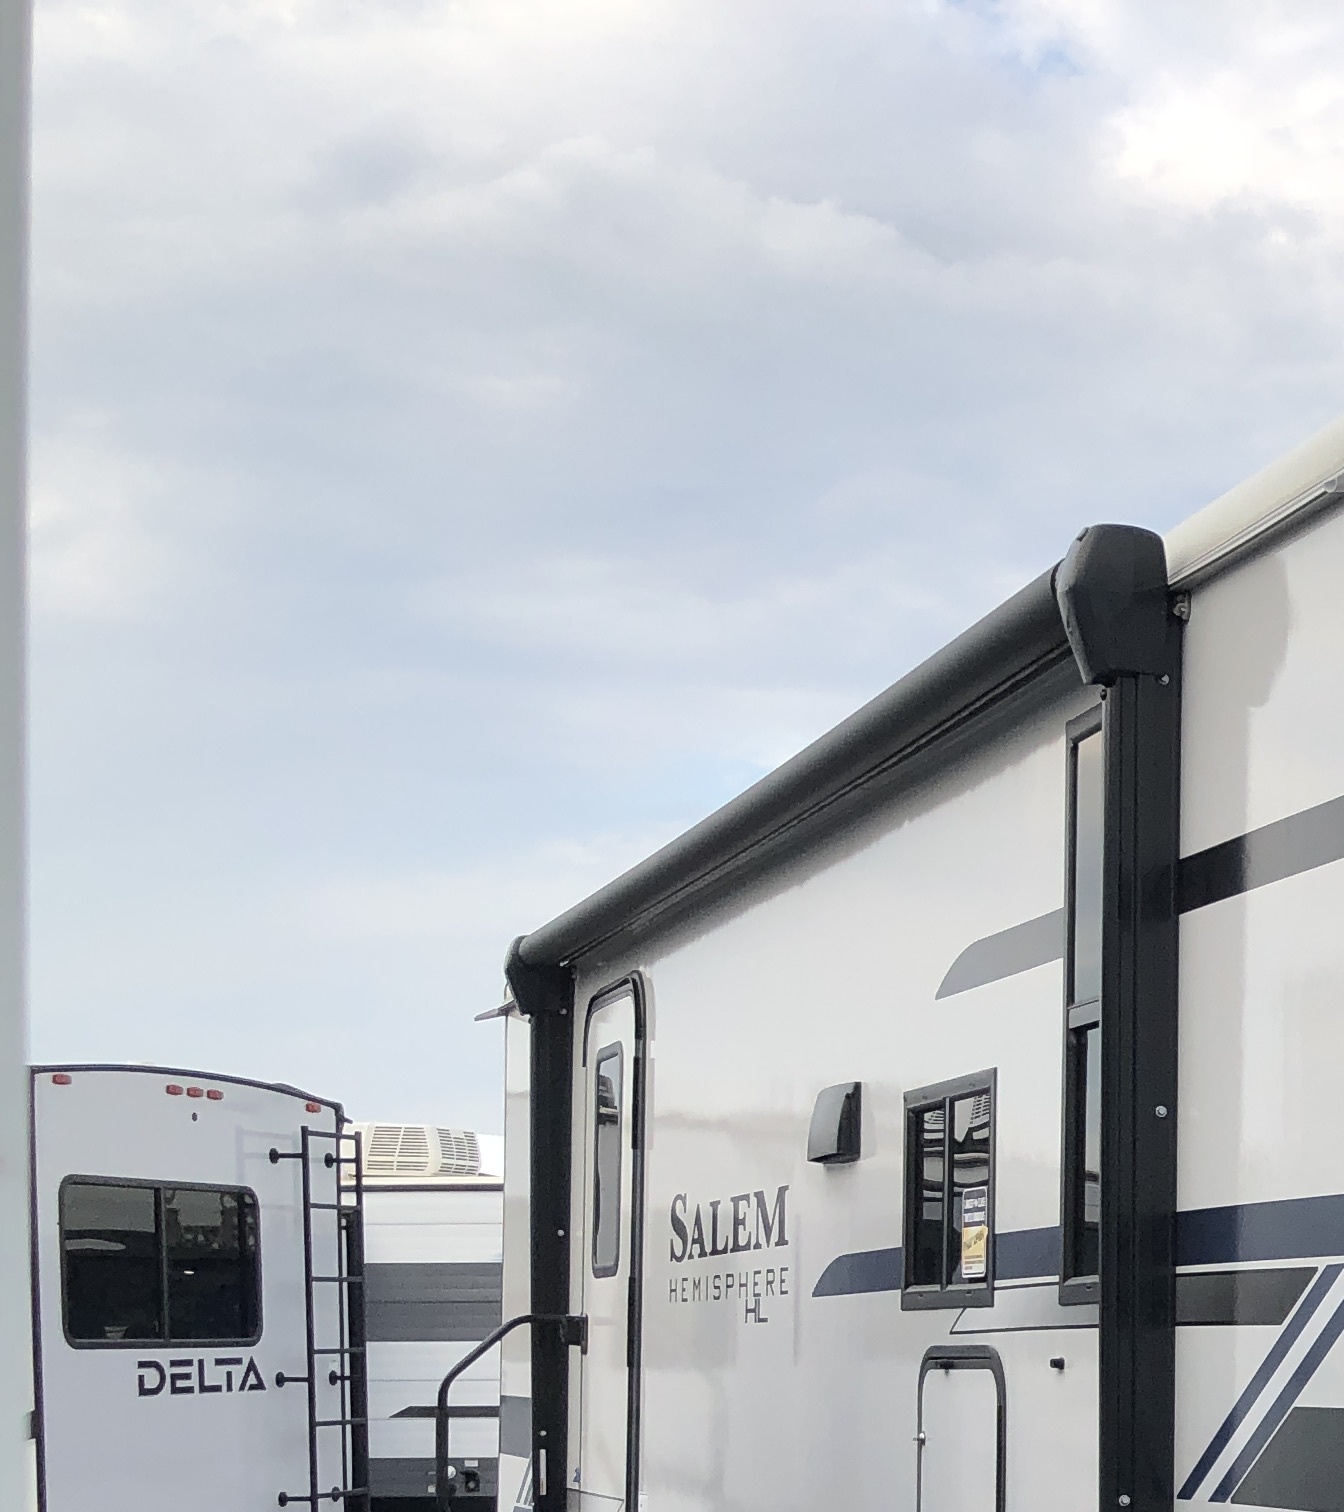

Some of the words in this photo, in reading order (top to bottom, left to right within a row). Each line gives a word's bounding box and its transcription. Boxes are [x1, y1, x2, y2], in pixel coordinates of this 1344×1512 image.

[669, 1185, 790, 1263] SALEM
[669, 1267, 789, 1303] HEMISPHERE
[745, 1298, 768, 1324] HL
[138, 1355, 267, 1397] DELTA
